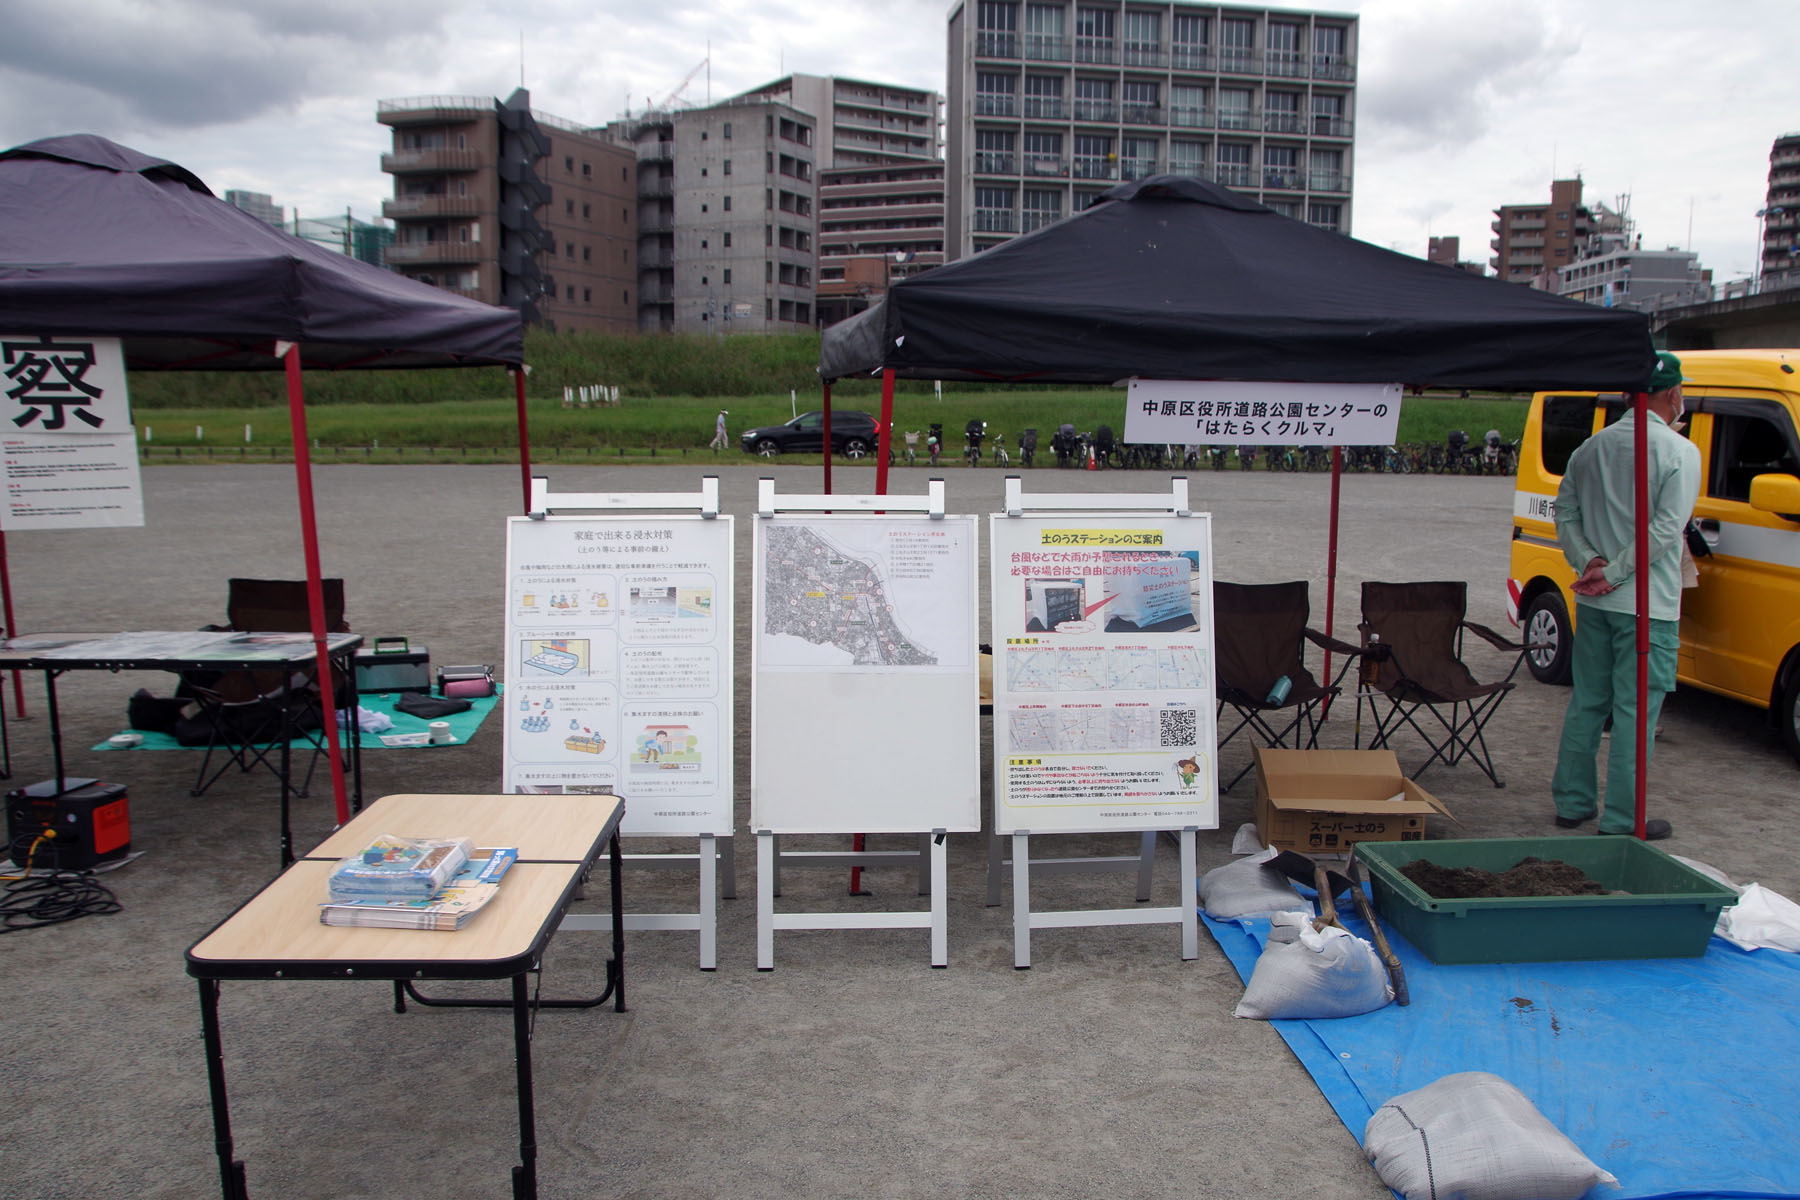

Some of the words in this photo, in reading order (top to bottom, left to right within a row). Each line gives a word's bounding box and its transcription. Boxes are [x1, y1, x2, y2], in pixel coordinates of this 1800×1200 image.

[1, 335, 104, 430] 察
[1142, 400, 1388, 418] 中原区役所道路公園センターの
[1196, 419, 1335, 437] 「はたらくクルマ」
[574, 529, 673, 541] 家庭で出来る浸水対策
[1041, 534, 1163, 545] 土のうステーションのご案内
[1010, 565, 1179, 576] 必要な場合はご自由にお持ちください
[1310, 821, 1386, 834] スーパー土のう
